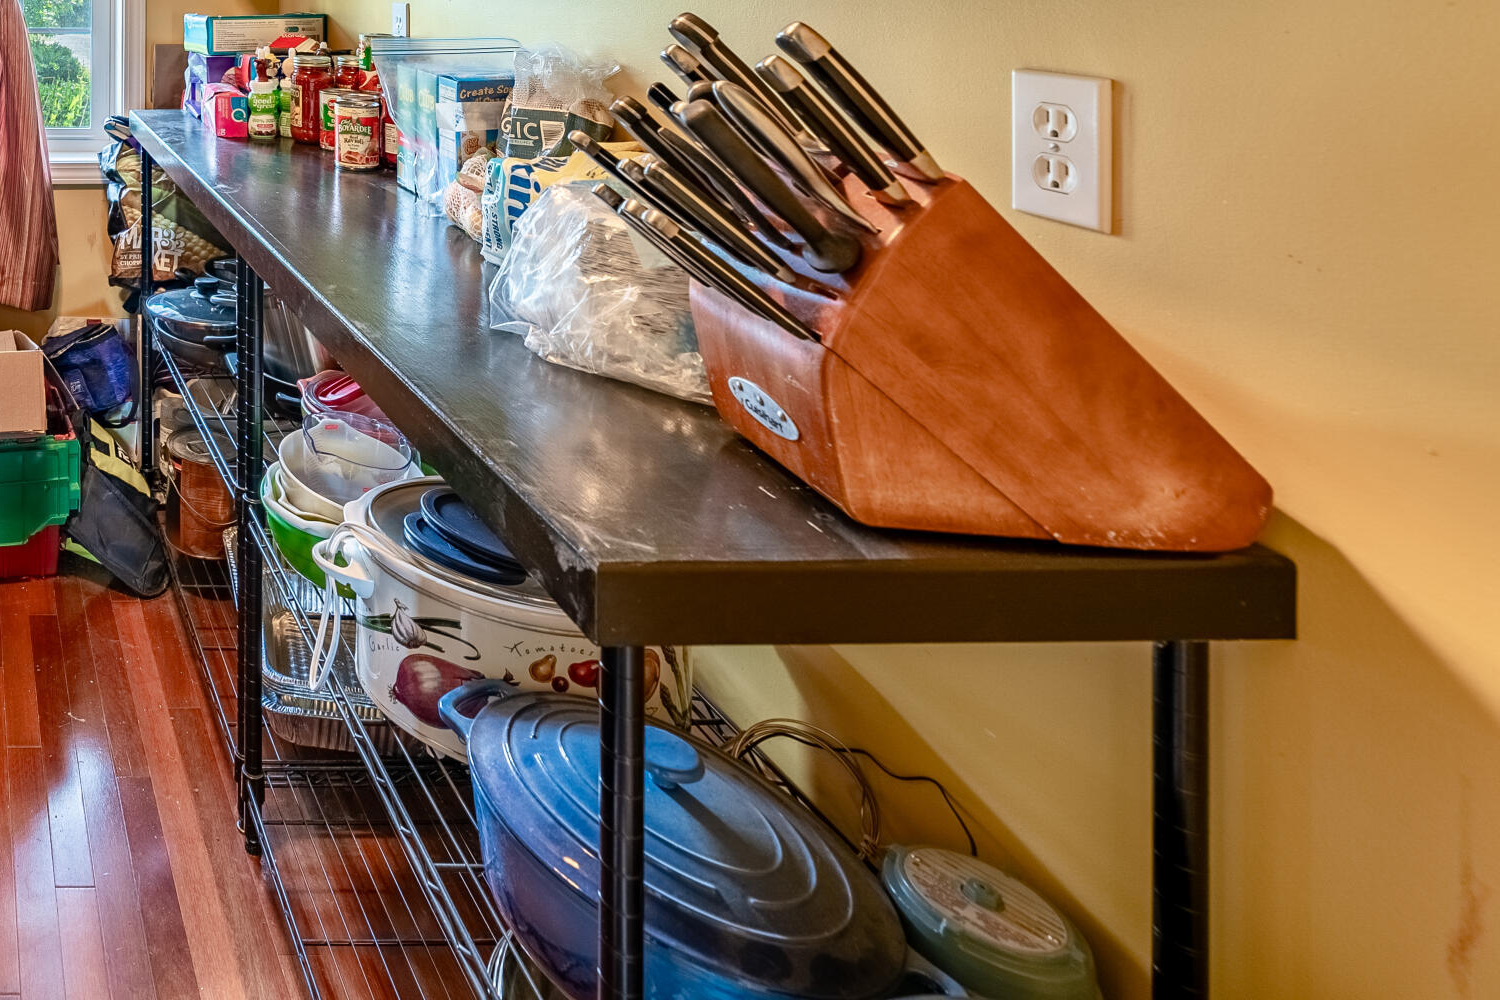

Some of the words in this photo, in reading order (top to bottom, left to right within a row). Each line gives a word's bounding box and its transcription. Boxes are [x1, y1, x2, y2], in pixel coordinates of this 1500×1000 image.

[459, 88, 495, 99] Create
[338, 122, 373, 135] BOYARDEE
[368, 634, 401, 653] Garlic
[504, 640, 595, 657] Tomatoes
